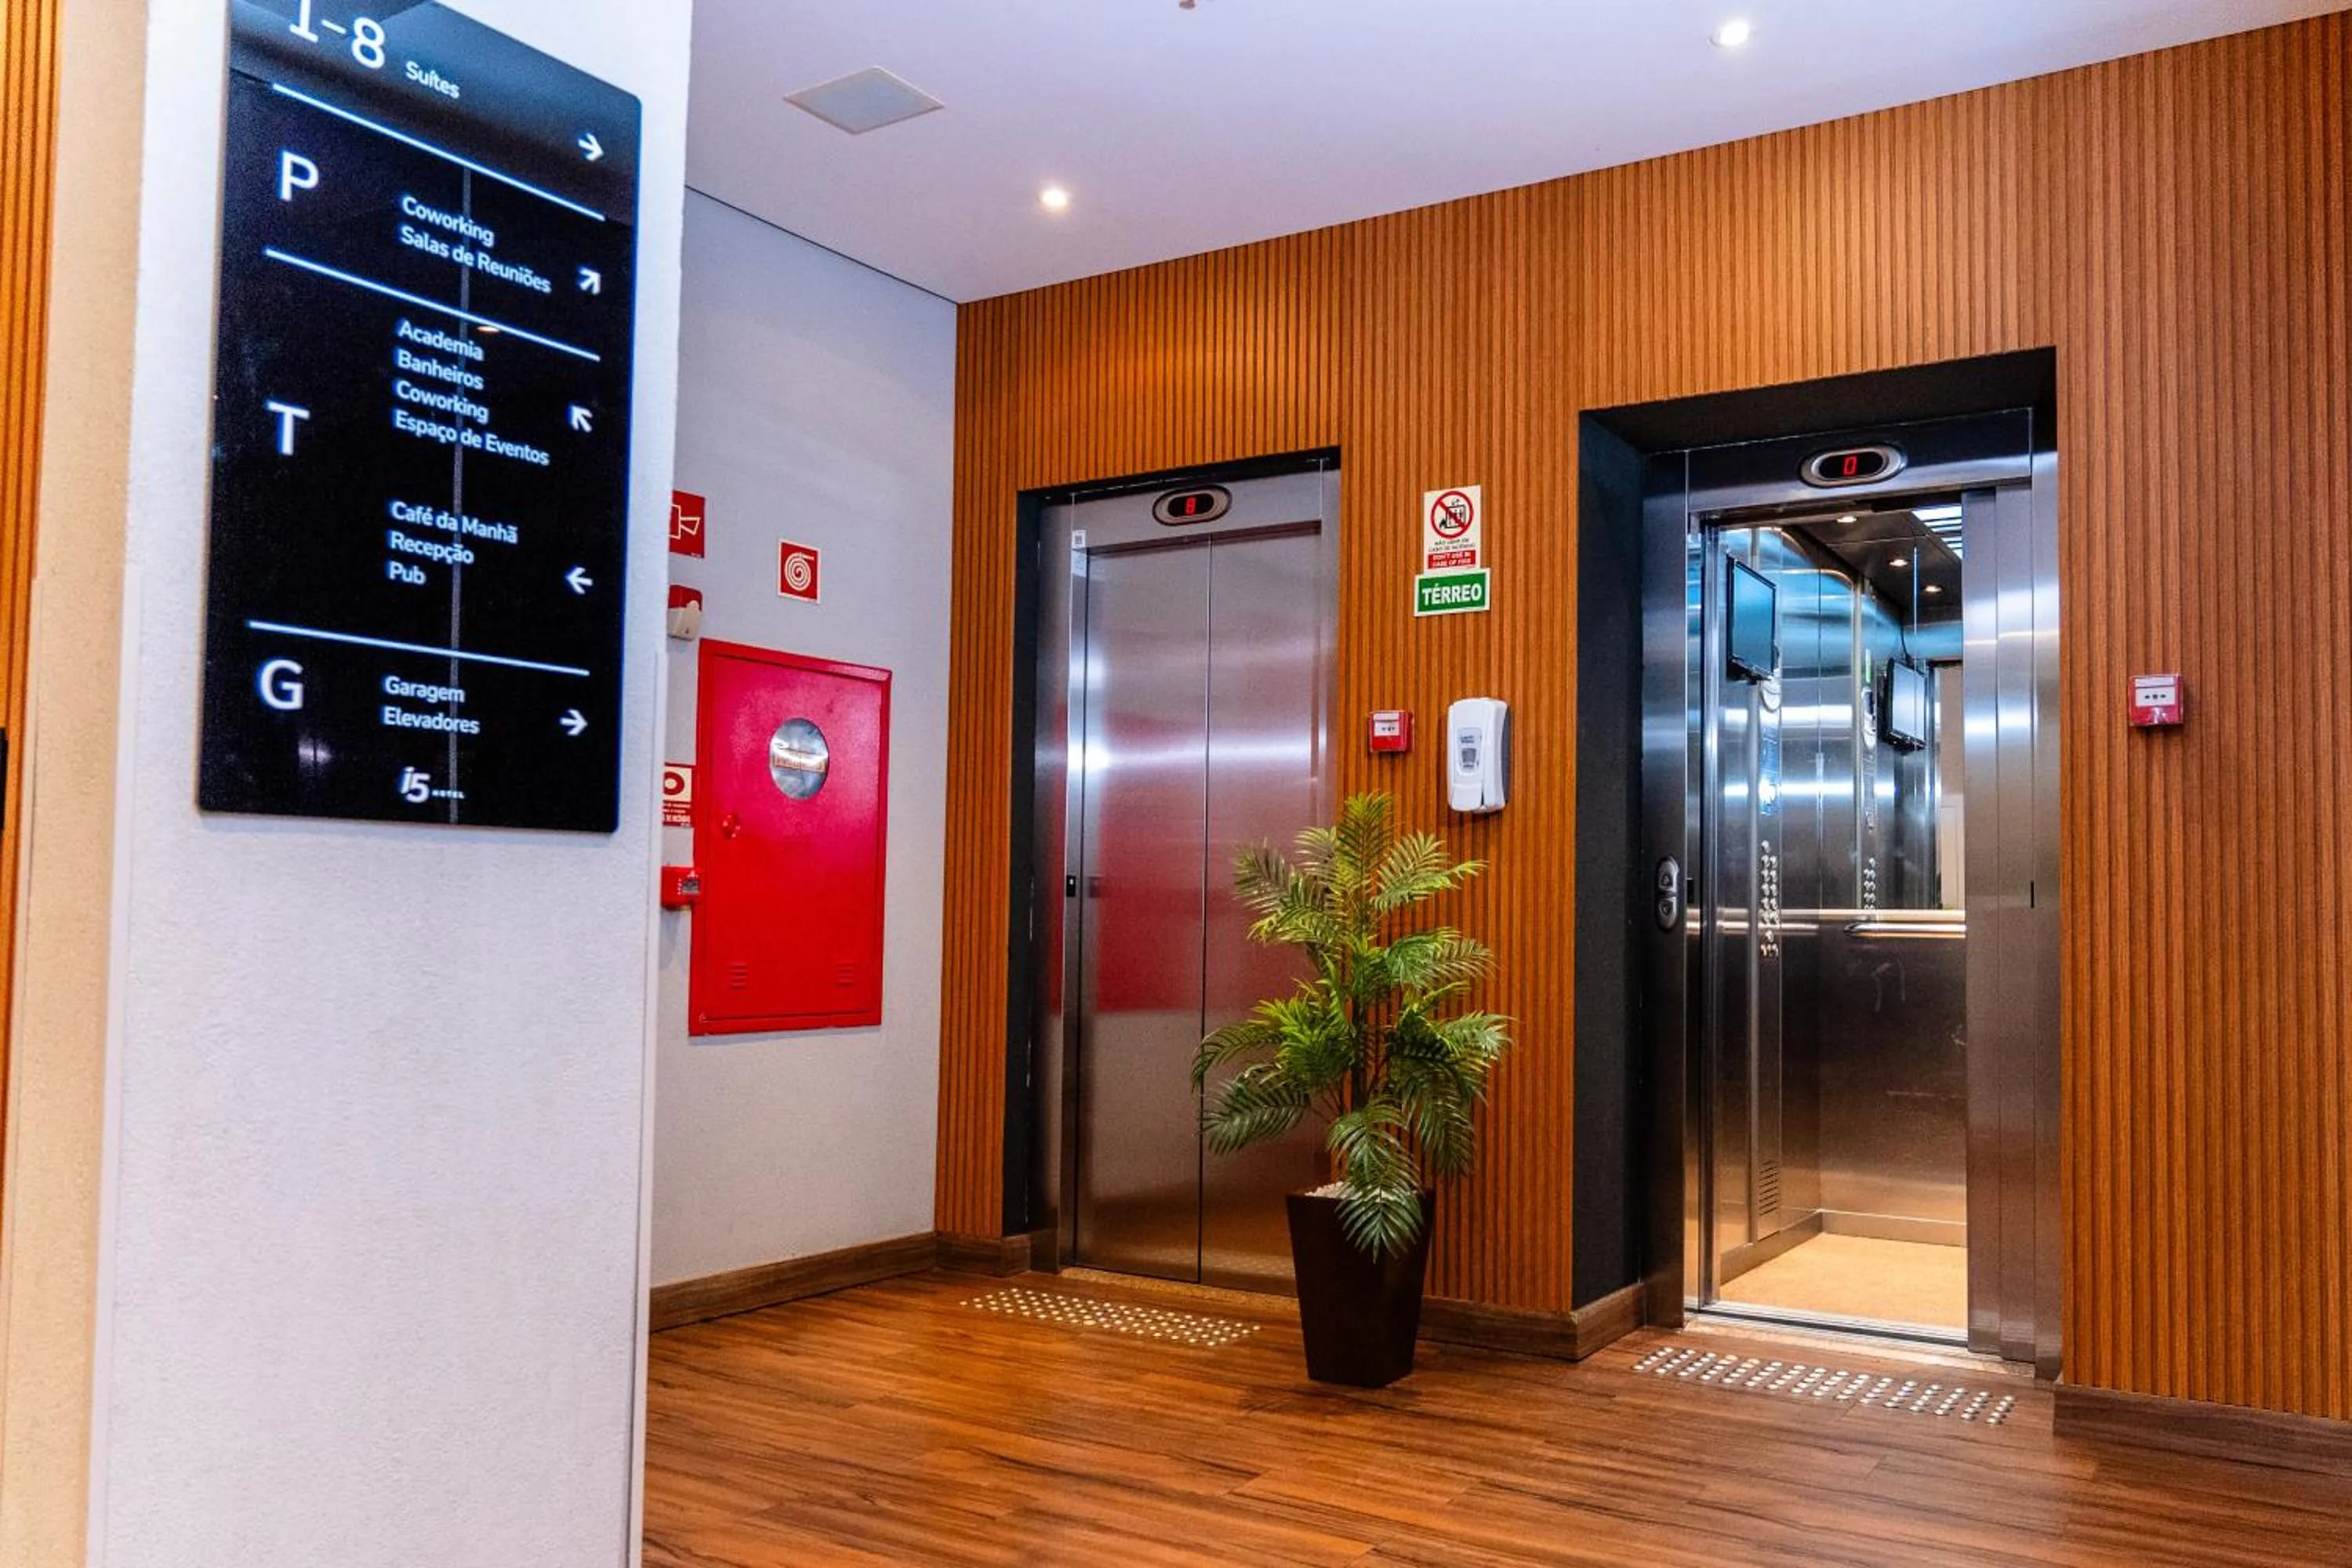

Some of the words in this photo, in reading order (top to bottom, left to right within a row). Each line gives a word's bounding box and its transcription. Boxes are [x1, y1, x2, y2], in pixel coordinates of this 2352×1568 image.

[281, 151, 319, 201] P
[402, 196, 494, 248] Coworking
[401, 226, 449, 258] Salas
[452, 246, 474, 267] de
[477, 252, 551, 293] Reuniões
[398, 320, 484, 361] Academia
[397, 350, 484, 390] Banheiros
[397, 380, 488, 424] Coworking
[267, 401, 310, 456] T
[396, 410, 458, 443] Espaço
[460, 429, 482, 448] de
[486, 434, 550, 465] Eventos
[1843, 456, 1857, 476] 0
[392, 501, 433, 526] Café
[437, 512, 459, 532] da
[463, 516, 517, 544] Manhã
[390, 532, 474, 564] Recepção
[390, 561, 426, 585] Pub
[1421, 583, 1483, 606] TÉRREO
[260, 659, 303, 710] G
[384, 675, 465, 704] Garagem
[383, 706, 480, 735] Elevadores
